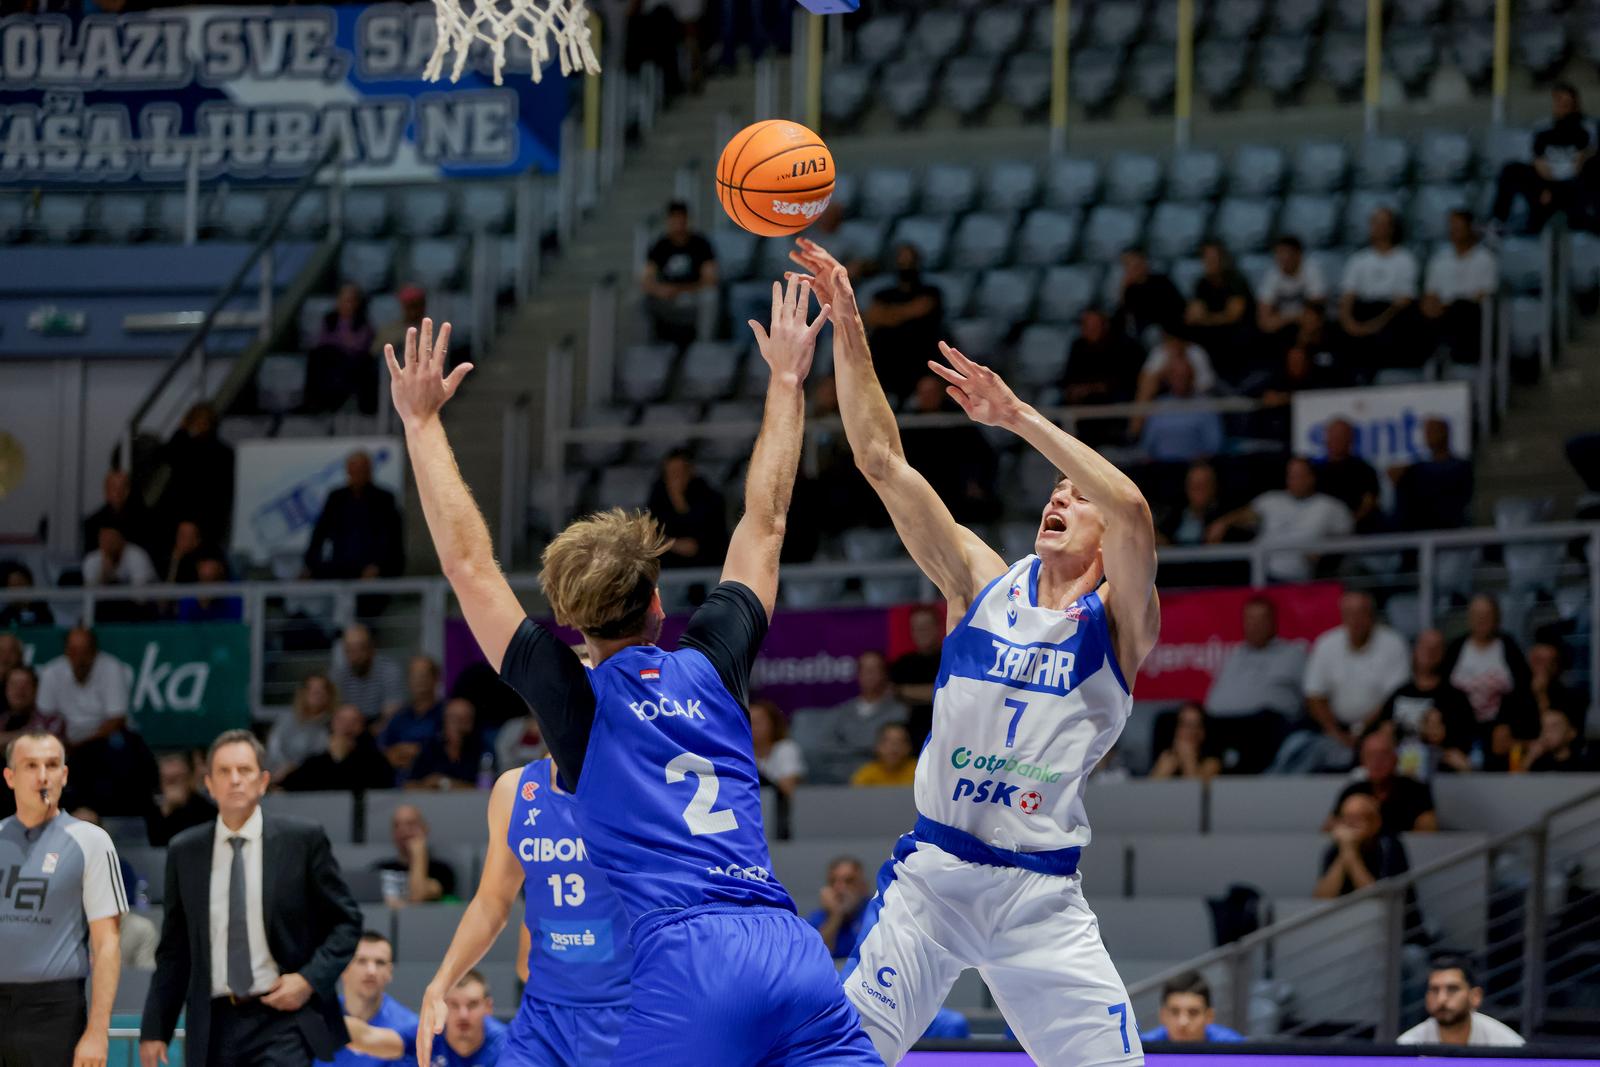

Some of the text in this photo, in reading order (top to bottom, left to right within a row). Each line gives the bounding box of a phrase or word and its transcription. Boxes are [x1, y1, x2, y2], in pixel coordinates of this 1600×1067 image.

[422, 101, 508, 155] NE
[987, 639, 1076, 691] ZADAR
[1004, 697, 1029, 749] 7
[665, 751, 739, 836] 2
[952, 777, 1021, 808] PSK
[547, 872, 586, 907] 13
[550, 931, 583, 946] ERSTE
[1107, 1002, 1131, 1054] 7
